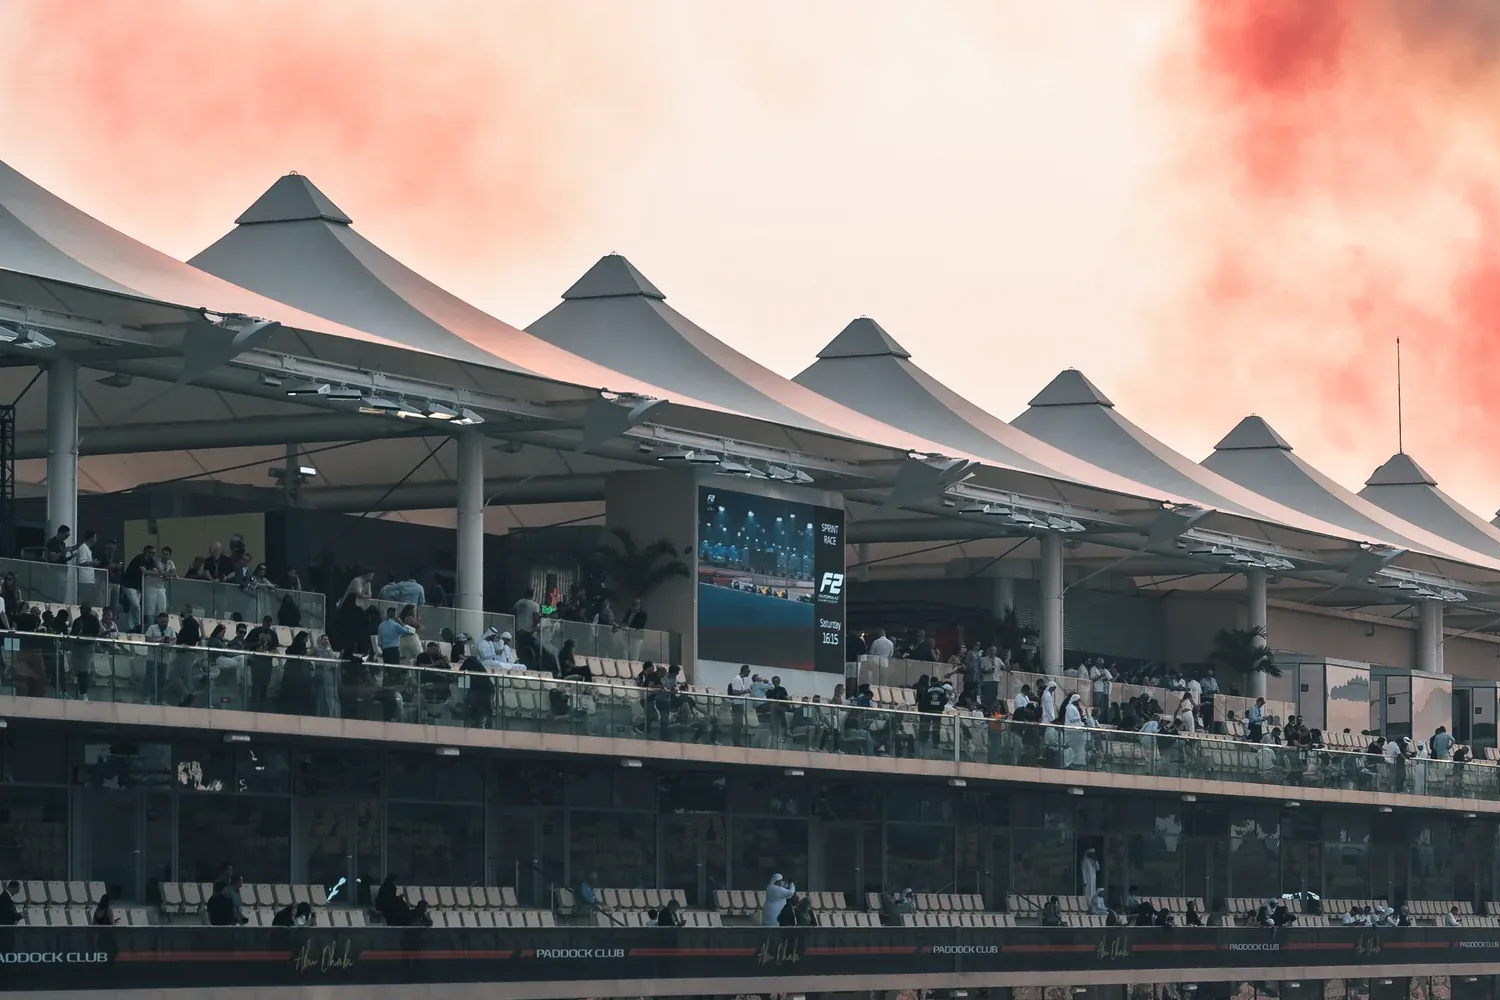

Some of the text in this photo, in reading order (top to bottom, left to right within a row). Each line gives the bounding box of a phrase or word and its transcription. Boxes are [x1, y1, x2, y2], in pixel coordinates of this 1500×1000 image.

[821, 523, 840, 534] SPRINT
[824, 535, 837, 545] RACE
[820, 572, 844, 595] F2
[820, 618, 842, 631] Saturday
[932, 944, 998, 954] PADDOCK CLUB
[1229, 942, 1281, 951] PADDOCK CLUB
[67, 952, 108, 962] CLUB
[295, 938, 354, 974] Abu Dhabi
[536, 948, 625, 960] PADDOCK CLUB
